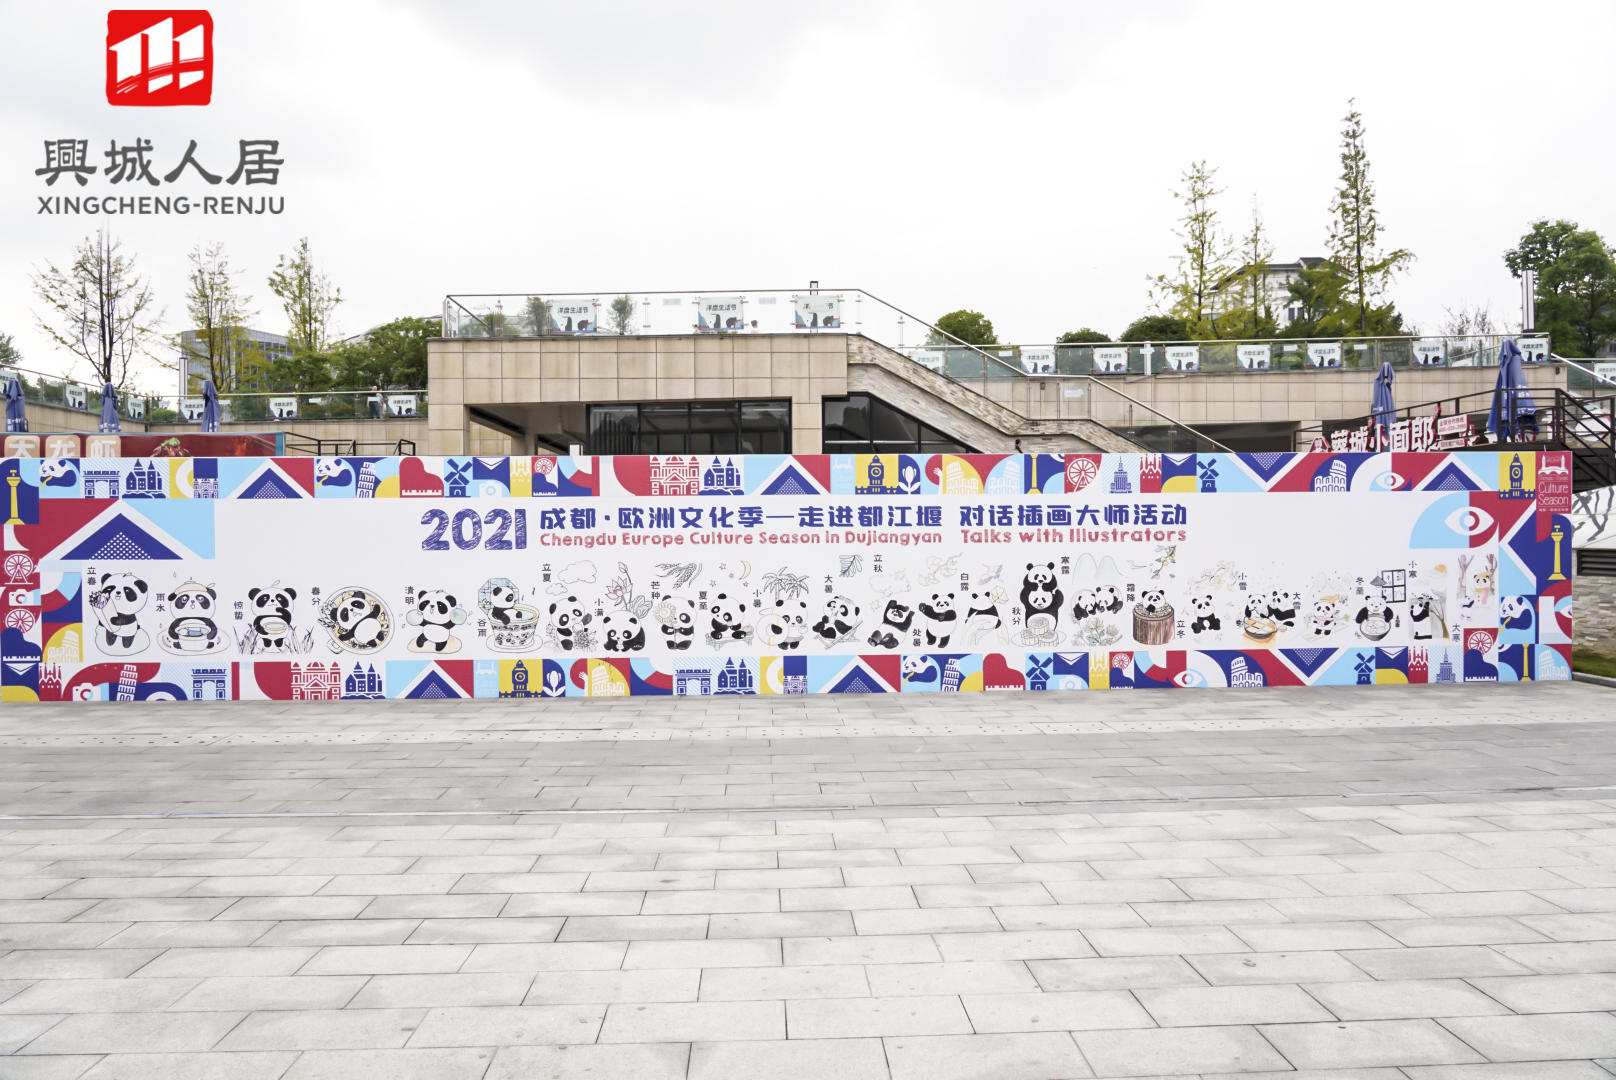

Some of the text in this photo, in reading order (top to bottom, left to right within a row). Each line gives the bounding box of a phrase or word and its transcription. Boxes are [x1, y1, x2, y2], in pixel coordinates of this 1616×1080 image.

[1538, 481, 1569, 494] Culture
[1538, 493, 1569, 506] Season
[959, 503, 1188, 528] 对话插画大师活动
[420, 508, 527, 551] 2021
[539, 527, 1188, 549] Chengdu Europe Culture Season in Dujiangyan Talks with Illustrators
[542, 563, 552, 583] 立夏
[873, 554, 883, 573] 立秋
[1408, 560, 1417, 579] 小寒
[86, 566, 97, 586] 立春
[960, 572, 969, 591] 白露
[311, 586, 321, 606] 春分
[404, 585, 415, 605] 清明
[650, 581, 661, 600] 芒种
[1126, 583, 1136, 603] 霜降
[155, 593, 166, 613] 雨水
[1011, 607, 1021, 625] 秋分
[477, 618, 487, 637] 谷雨
[1176, 620, 1186, 639] 立冬
[1452, 623, 1461, 642] 大寒
